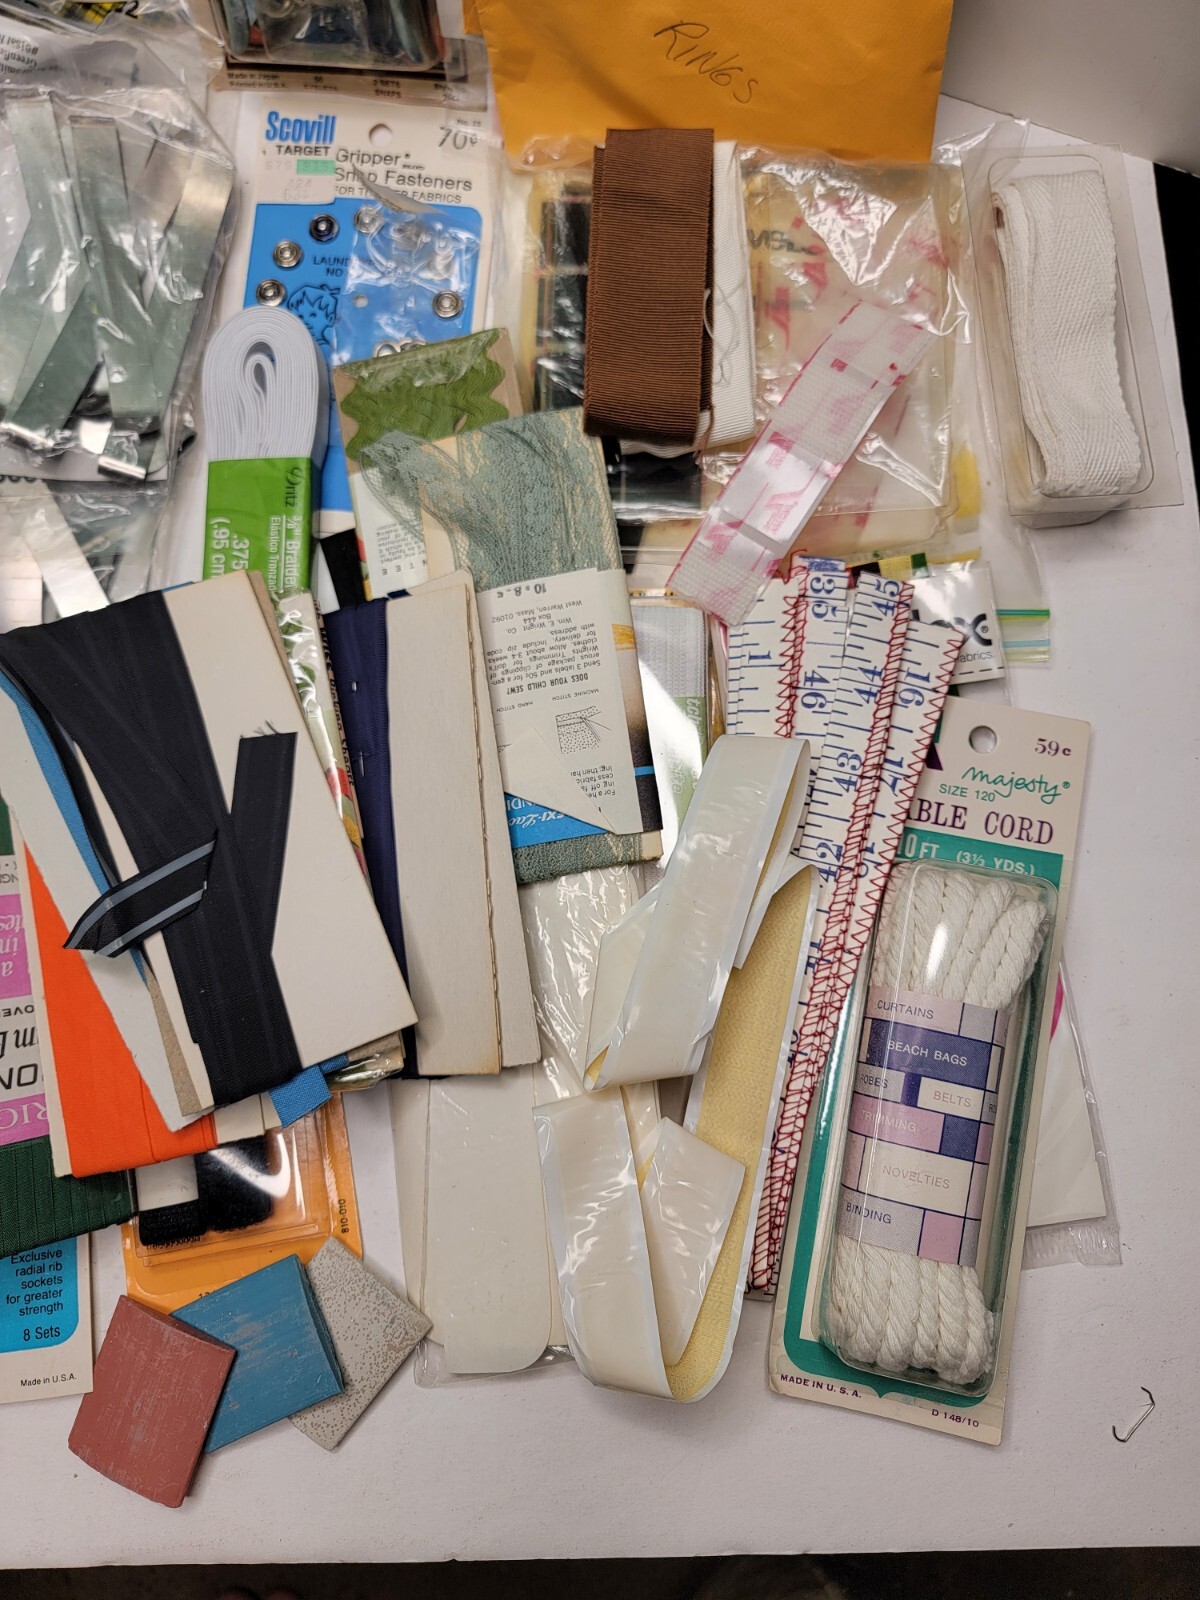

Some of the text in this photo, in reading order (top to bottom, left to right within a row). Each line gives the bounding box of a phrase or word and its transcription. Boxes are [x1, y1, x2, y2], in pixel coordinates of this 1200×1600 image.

[265, 111, 336, 145] Scovill
[275, 145, 331, 157] TARGET
[385, 170, 473, 192] Fasteners
[412, 191, 462, 204] FABRICS
[285, 467, 305, 508] Dritz
[567, 600, 583, 608] West
[522, 622, 547, 633] Wright
[548, 622, 595, 636] with address.
[586, 630, 597, 638] for
[486, 648, 503, 657] code
[507, 644, 519, 653] zip
[526, 648, 546, 657] about
[551, 643, 567, 652] Allow
[571, 645, 599, 655] Wrights
[487, 655, 509, 664] weeks
[512, 658, 523, 666] for
[529, 650, 566, 663] Trimmings
[547, 655, 576, 667] package
[581, 652, 600, 661] erous
[958, 650, 993, 663] abrics
[501, 664, 532, 676] clippings
[539, 667, 553, 676] and
[553, 665, 576, 675] labels
[585, 660, 601, 670] Send
[506, 672, 589, 695] DOES YOUR CHILD SEW?
[512, 674, 524, 682] for
[582, 767, 598, 775] then
[576, 772, 614, 784] cess fabric
[603, 780, 615, 788] ing
[590, 782, 601, 790] off
[939, 783, 996, 803] SIZE 120
[906, 798, 1055, 845] BLE CORD
[904, 833, 918, 858] 0
[919, 843, 940, 859] FT
[993, 857, 1036, 875] YDS.)
[876, 999, 935, 1020] CURTAINS
[887, 1039, 968, 1067] BEACH BAGS
[933, 1090, 972, 1108] BELTS
[861, 1109, 918, 1133] TRIMMING
[882, 1164, 951, 1190] NOVELTIES
[846, 1201, 893, 1225] BINDING
[10, 1249, 63, 1265] Exclusive
[15, 1261, 63, 1278] radial rib
[21, 1276, 63, 1290] sockets
[6, 1288, 63, 1305] for greater
[19, 1301, 64, 1317] strength
[23, 1325, 61, 1342] 8 Sets
[20, 1372, 77, 1388] Made in U.S.A.
[780, 1373, 810, 1387] MADE
[812, 1380, 824, 1390] IN
[931, 1408, 980, 1428] D 148/10
